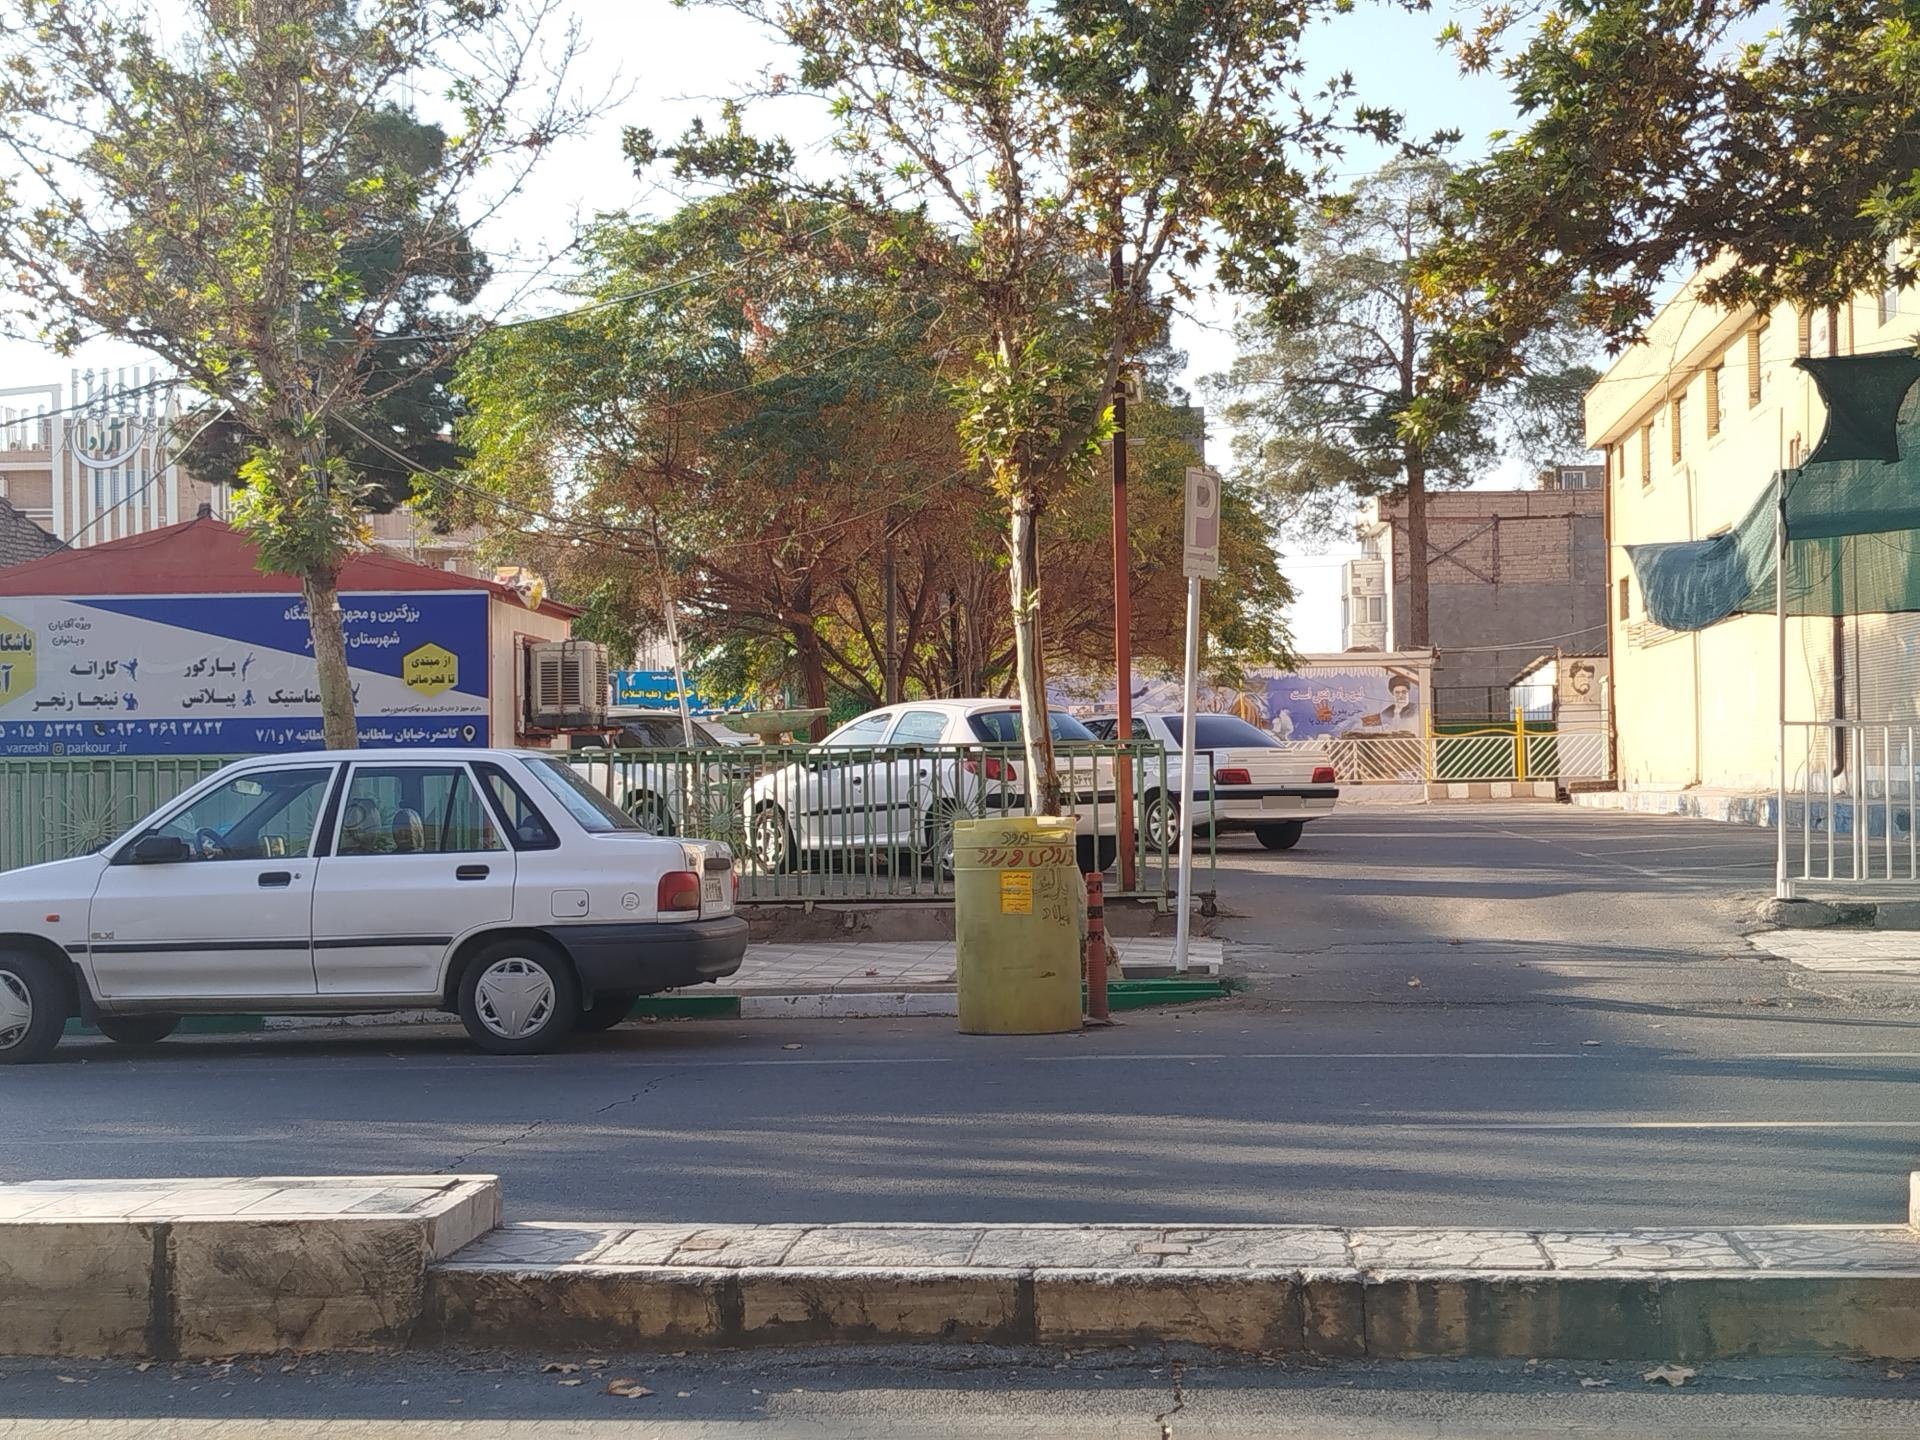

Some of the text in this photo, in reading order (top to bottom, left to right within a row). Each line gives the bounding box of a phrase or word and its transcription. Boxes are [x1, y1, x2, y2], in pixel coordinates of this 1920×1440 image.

[48, 617, 92, 632] ویژه آقایان
[370, 610, 377, 624] و
[0, 632, 33, 656] باشگا
[350, 631, 401, 649] شهرستان
[69, 659, 119, 680] کاراته
[183, 657, 237, 678] پارکور
[411, 655, 451, 669] از مبتدی
[406, 673, 456, 686] تا قهرمانی
[31, 691, 119, 712] نینجا رنجر
[181, 687, 237, 708] پیلاتس
[268, 688, 322, 707] مناستیک
[295, 728, 326, 744] لطانیه
